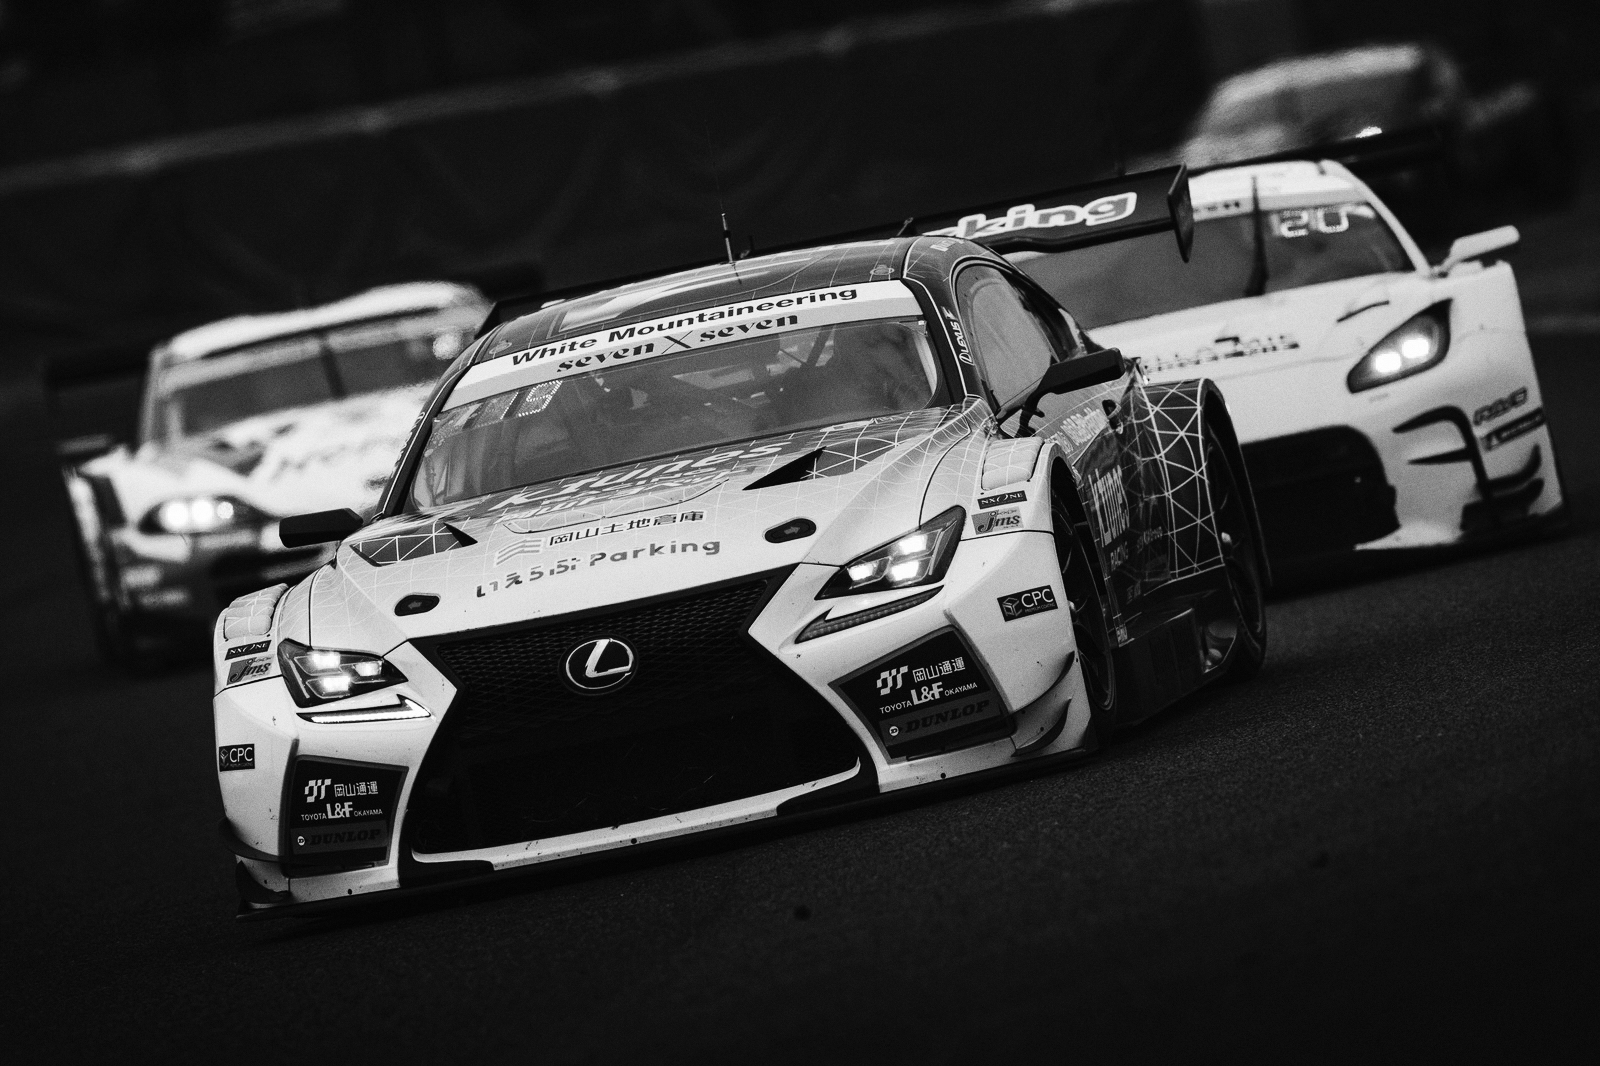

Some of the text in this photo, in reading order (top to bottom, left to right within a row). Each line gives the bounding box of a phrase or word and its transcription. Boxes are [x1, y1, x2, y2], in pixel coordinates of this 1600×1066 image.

[923, 192, 1138, 238] king
[511, 289, 859, 366] White Mountaineering
[950, 320, 970, 354] LEXUS
[556, 343, 655, 373] seven
[699, 314, 798, 343] seven
[589, 539, 720, 567] Parking
[1021, 588, 1053, 607] CPC
[912, 656, 966, 683] 岡山通運
[879, 681, 978, 714] TOYOTA L&F OKAYAMA
[904, 700, 990, 733] DUNLOP
[229, 747, 253, 763] CPC
[334, 781, 379, 798] 岡山通運
[300, 801, 383, 821] TOYOTA L&F OKAYAMA
[309, 828, 382, 846] DUNLOP
